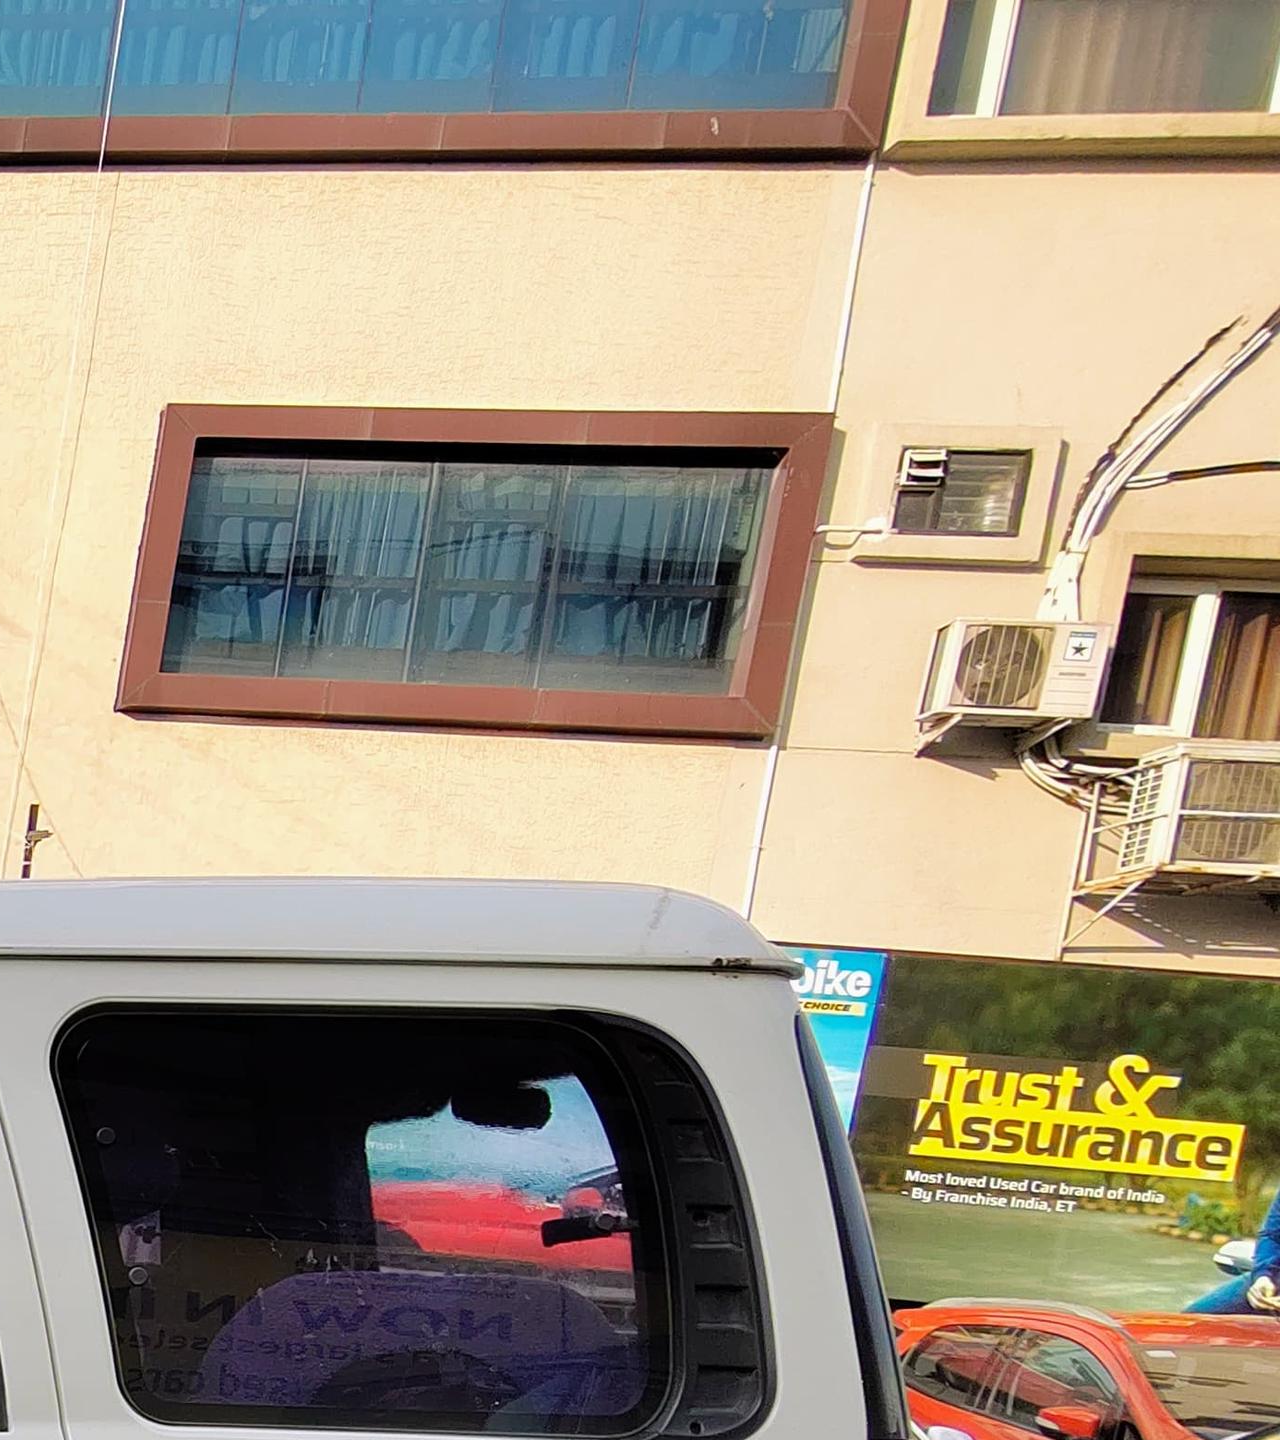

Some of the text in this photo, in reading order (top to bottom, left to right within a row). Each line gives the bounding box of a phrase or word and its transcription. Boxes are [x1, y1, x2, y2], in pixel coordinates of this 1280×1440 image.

[790, 957, 872, 998] bike
[803, 1001, 852, 1012] CHOICE
[923, 1053, 1182, 1117] Trust &
[913, 1100, 1232, 1171] Assurance
[904, 1169, 1166, 1204] Most loved Used Car brand of India
[911, 1186, 933, 1203] By
[935, 1189, 1008, 1208] Franchise
[1010, 1196, 1052, 1213] India,
[1055, 1200, 1078, 1213] ET
